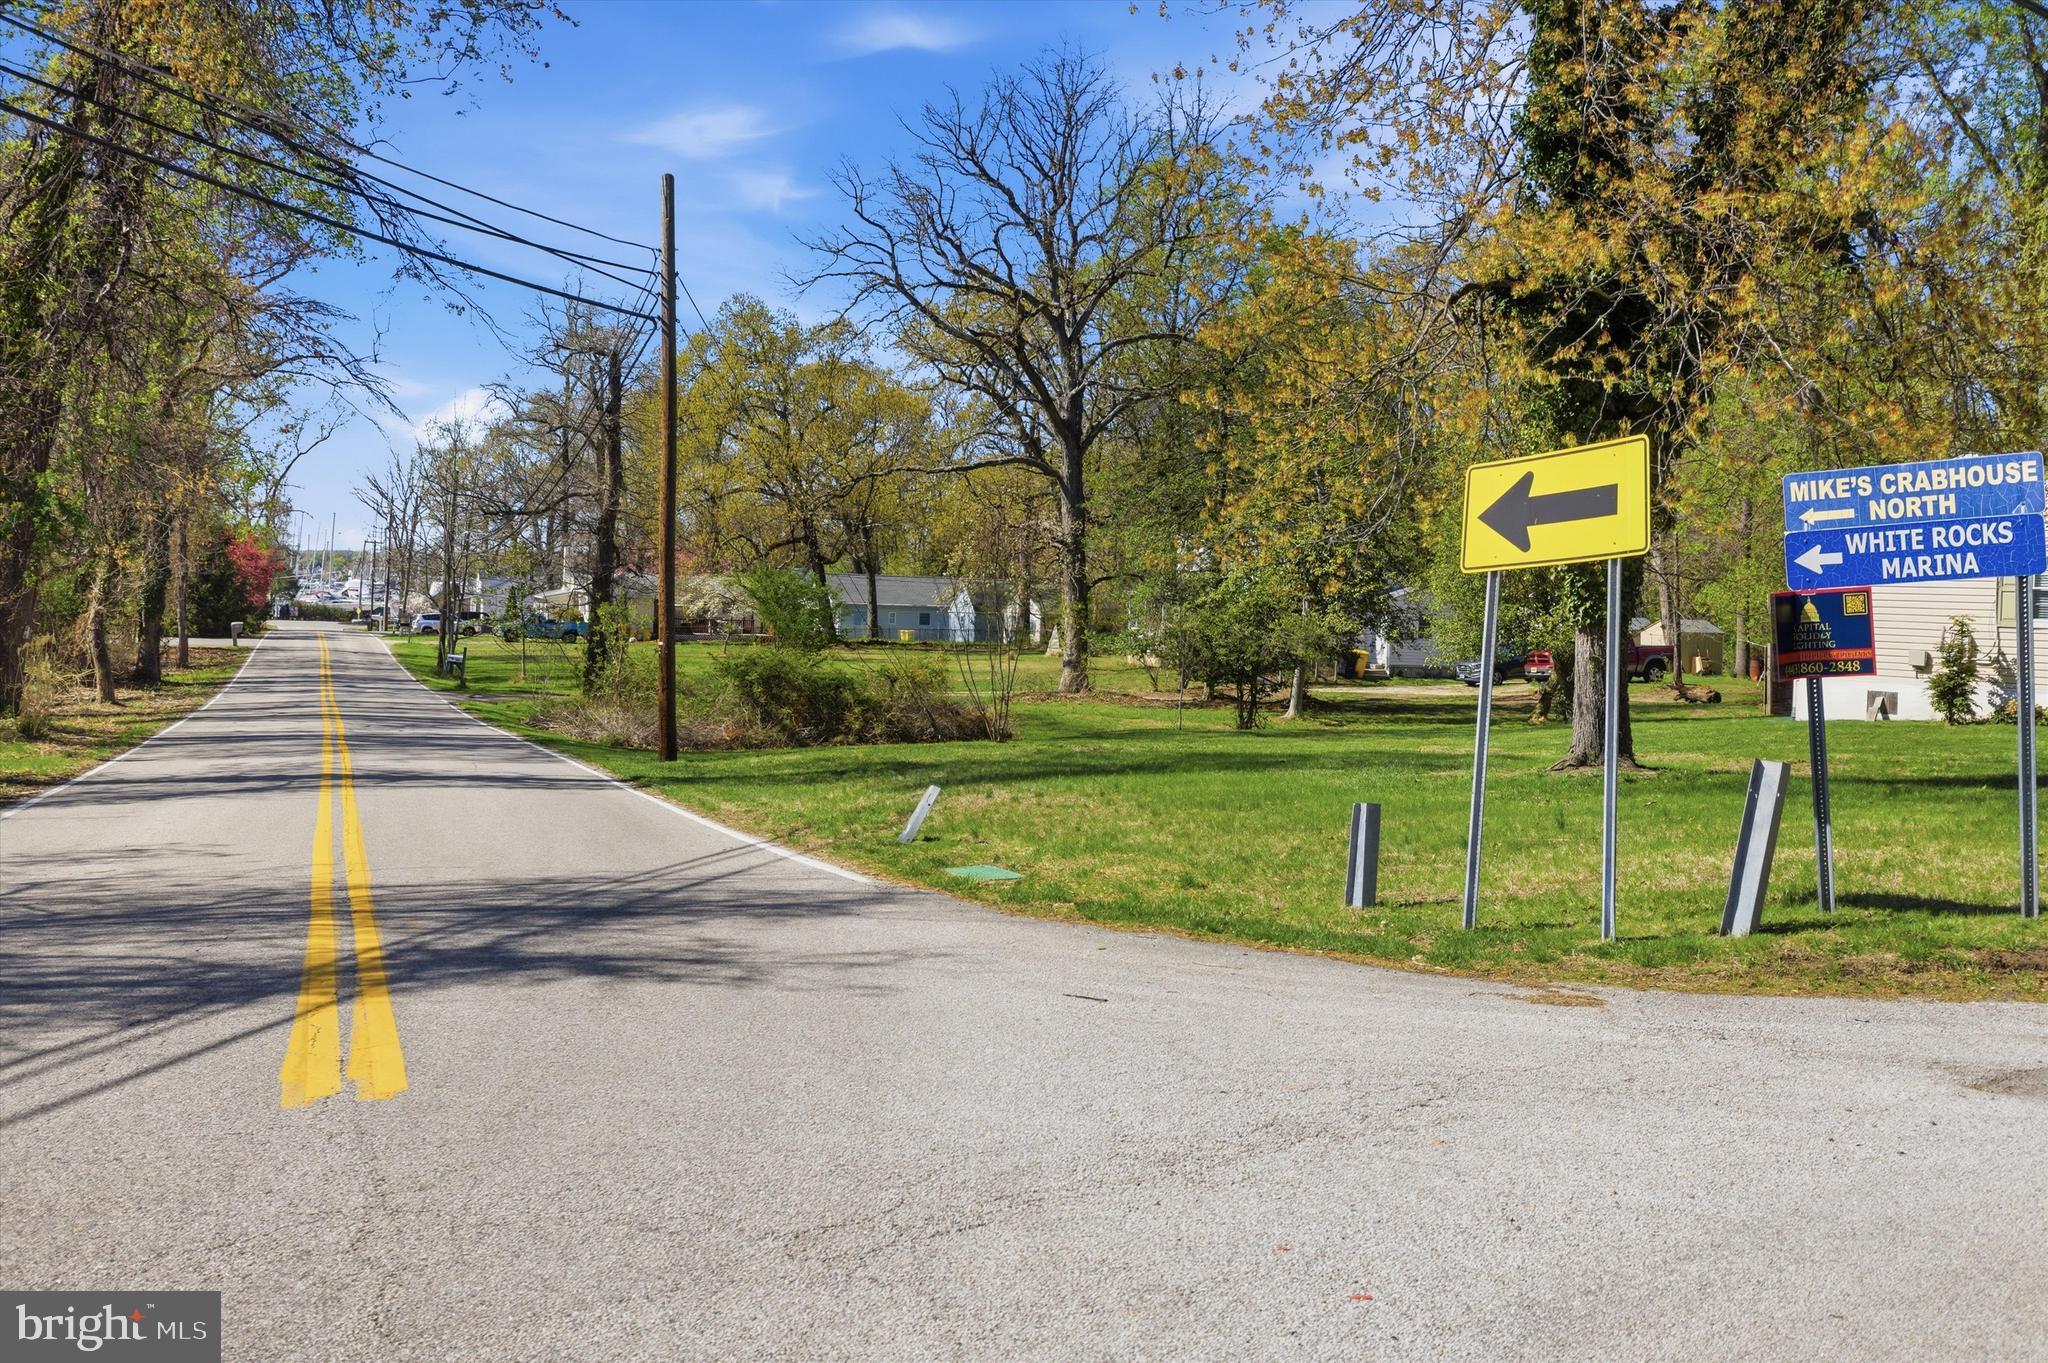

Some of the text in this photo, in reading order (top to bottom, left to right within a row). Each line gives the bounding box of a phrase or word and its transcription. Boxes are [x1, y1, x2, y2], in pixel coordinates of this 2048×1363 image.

[1789, 460, 2038, 502] MIKE'S CRABHOUSE
[1869, 493, 1957, 521] NORTH
[1845, 521, 2014, 555] WHITE ROCKS
[1881, 552, 1980, 579] MARINA
